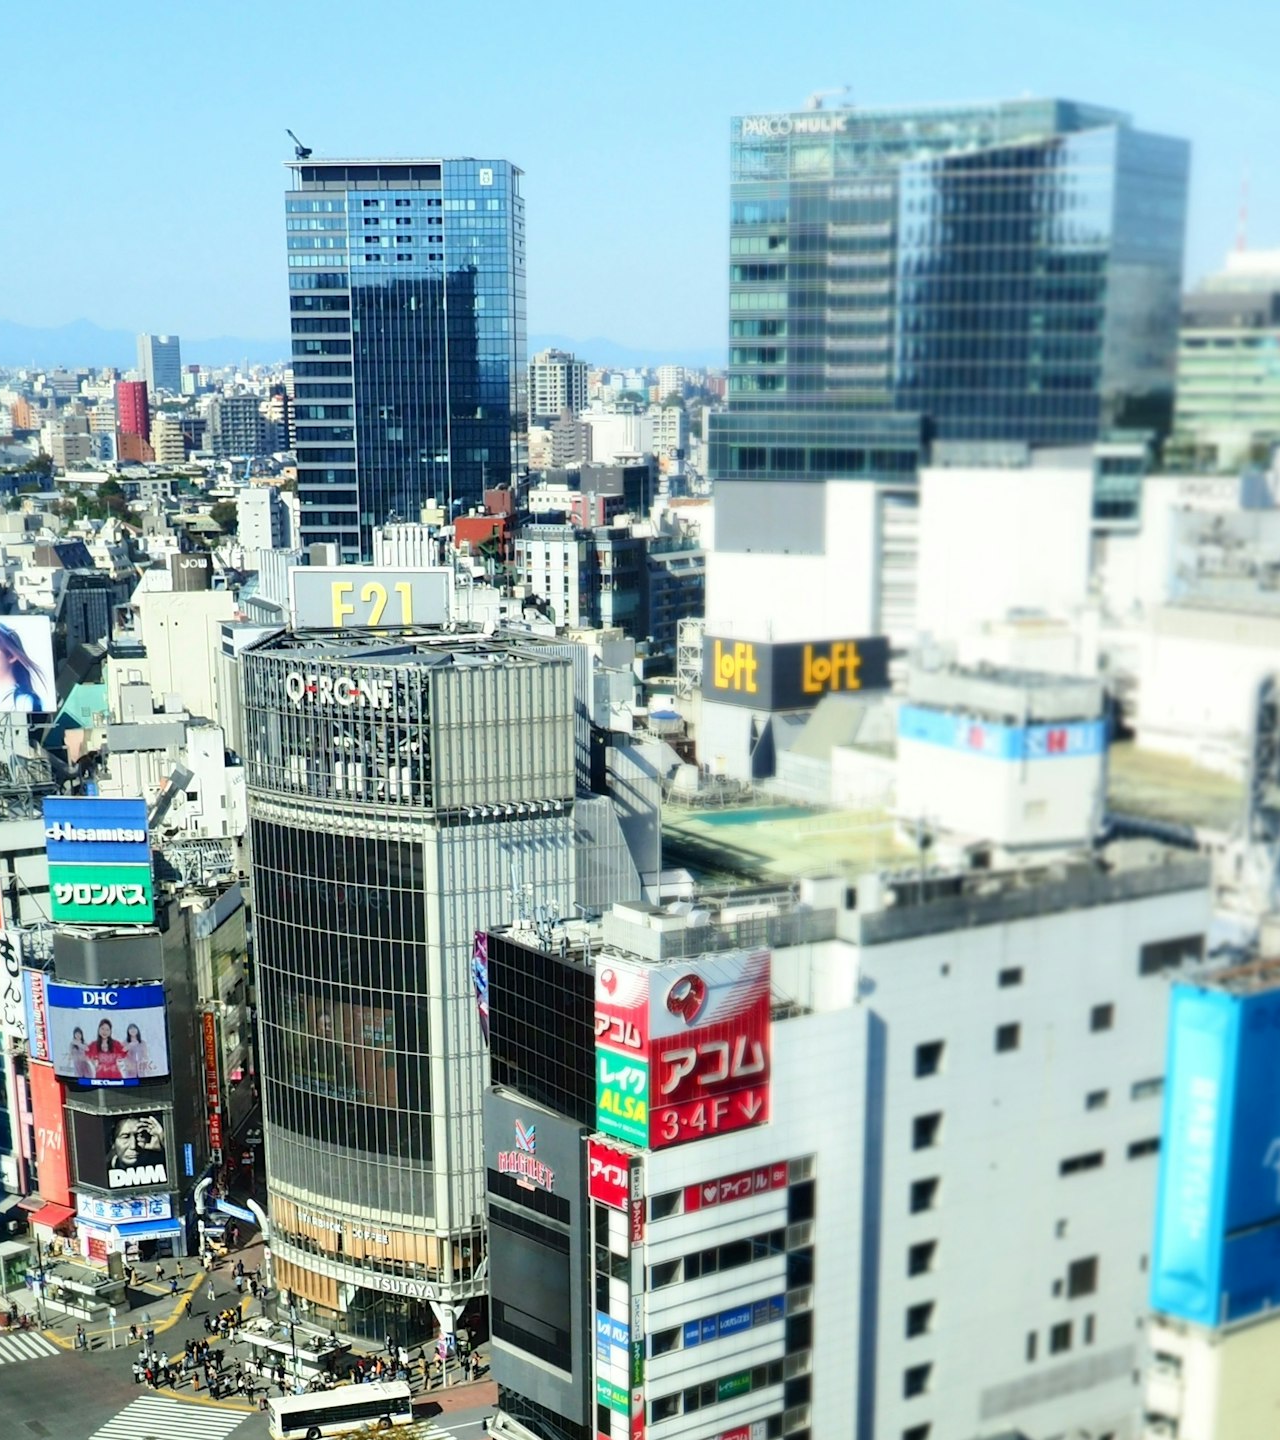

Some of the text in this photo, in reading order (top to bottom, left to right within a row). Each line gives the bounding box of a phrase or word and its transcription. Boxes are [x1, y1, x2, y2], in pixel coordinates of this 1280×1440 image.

[742, 116, 847, 137] PARCO HULIC
[331, 581, 412, 635] F21
[286, 671, 392, 709] QFRONT
[46, 822, 145, 841] Hisamitsu
[53, 883, 146, 905] サロンパス
[0, 933, 26, 1036] もんじゃ
[82, 991, 118, 1006] DHC
[595, 1011, 642, 1049] アコム
[600, 1057, 646, 1094] レイク
[661, 1036, 765, 1095] アコム
[599, 1088, 646, 1124] ALSA
[108, 1164, 167, 1188] DMM
[498, 1151, 556, 1192] MAGNET
[720, 1172, 768, 1199] アイフル
[82, 1199, 163, 1218] 大盛堂書店
[352, 1228, 389, 1245] COFFEE
[632, 1210, 643, 1241] アイフル
[374, 1275, 436, 1299] TSUTAYA
[597, 1383, 611, 1397] レイク
